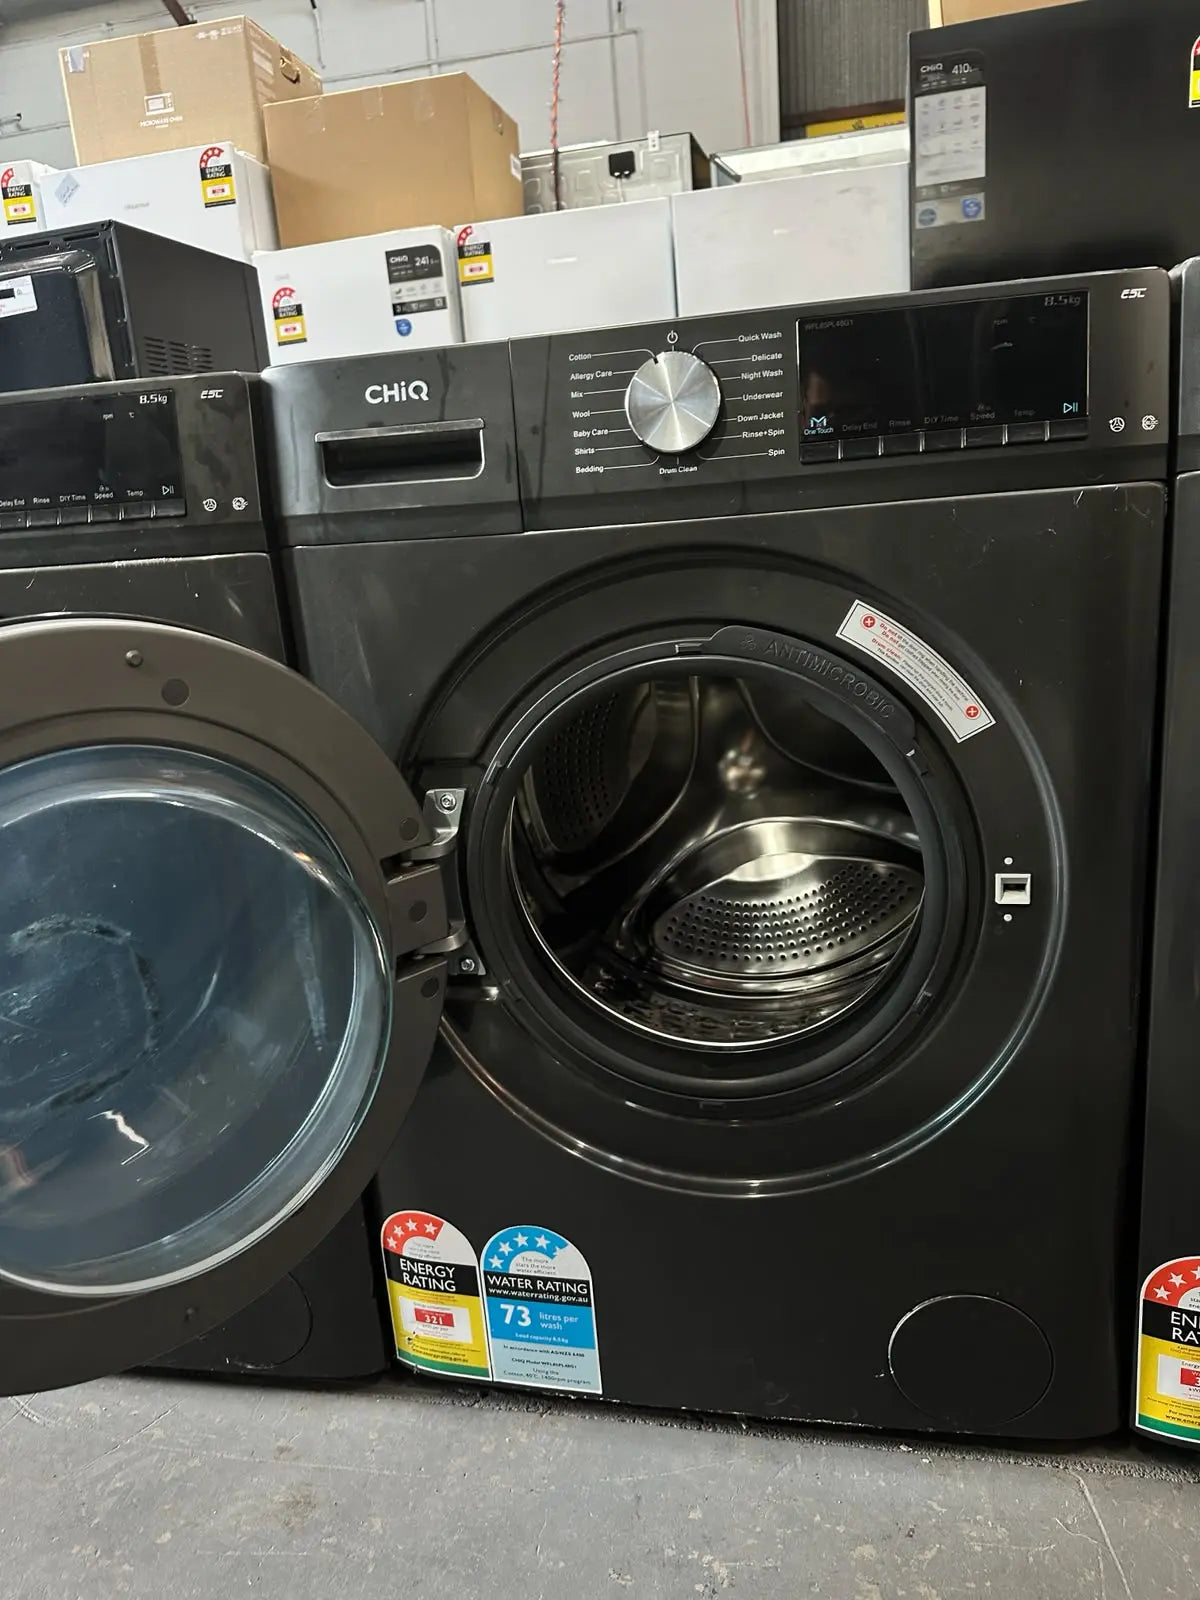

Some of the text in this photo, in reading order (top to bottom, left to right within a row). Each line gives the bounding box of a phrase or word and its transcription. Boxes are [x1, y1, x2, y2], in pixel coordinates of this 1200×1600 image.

[738, 331, 782, 343] Quick Wash
[568, 352, 592, 361] Cotton
[751, 352, 783, 361] Delicate
[570, 371, 596, 381] Allergy
[741, 369, 783, 381] Night Wash
[365, 380, 429, 404] CHiQ
[742, 391, 783, 401] Underwear
[103, 412, 113, 420] rpm
[737, 411, 784, 422] Down Jacket
[573, 428, 609, 438] Baby Care
[742, 427, 785, 439] Rinse+Spin
[803, 428, 816, 436] One
[574, 447, 595, 455] Shirts
[768, 447, 785, 457] Spin
[575, 465, 604, 474] Bedding
[659, 465, 697, 475] Drum Clean
[71, 493, 86, 501] Time
[94, 492, 113, 500] Speed
[127, 489, 144, 497] Temp
[887, 628, 896, 636] not
[871, 638, 886, 648] Drum
[889, 636, 898, 644] not
[764, 639, 895, 719] ANTIMICROBIC
[399, 1257, 455, 1278] ENERGY
[403, 1273, 456, 1292] RATING
[487, 1275, 588, 1294] WATER RATING
[488, 1287, 588, 1303] www.waterrating.gov.au
[425, 1314, 443, 1325] 321
[500, 1303, 579, 1327] 73 litres per
[540, 1321, 563, 1330] wash
